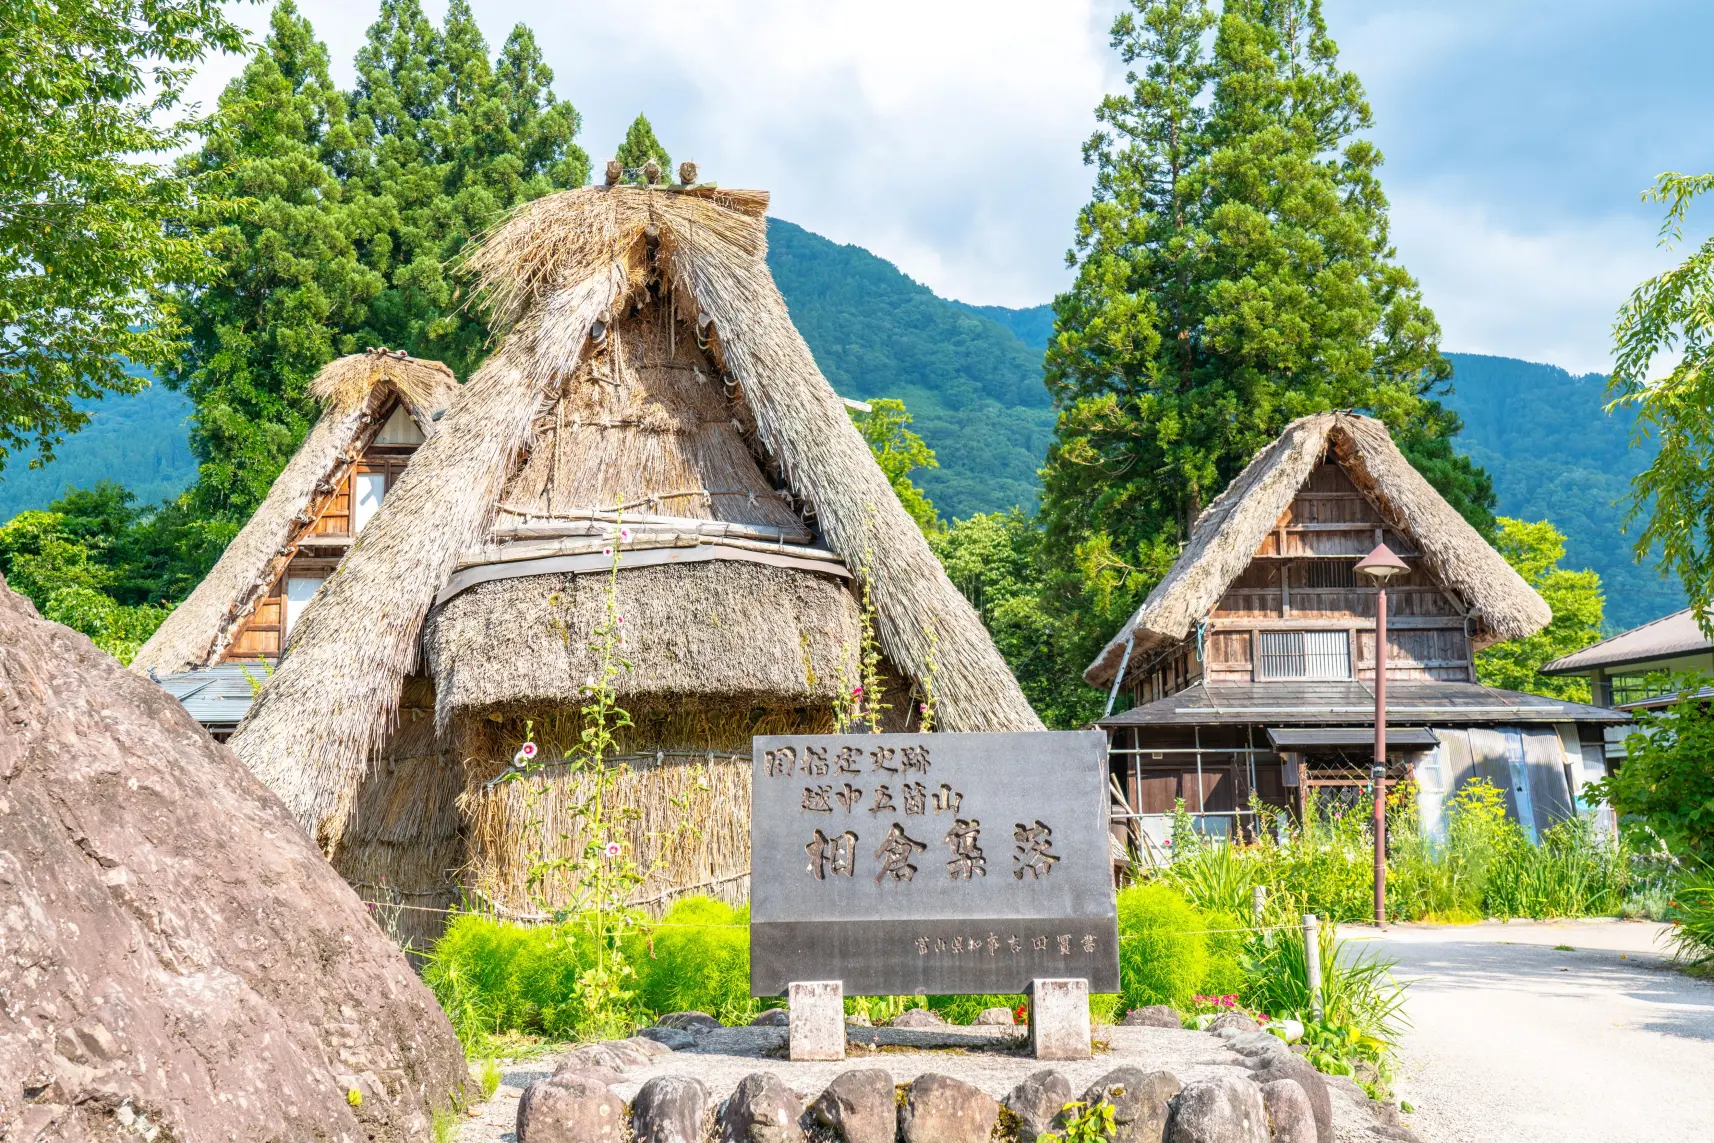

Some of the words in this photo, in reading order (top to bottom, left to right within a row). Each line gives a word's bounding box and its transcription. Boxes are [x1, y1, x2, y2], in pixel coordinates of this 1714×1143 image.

[800, 782, 964, 815] 越中五箇山
[805, 818, 1060, 882] 相倉集落
